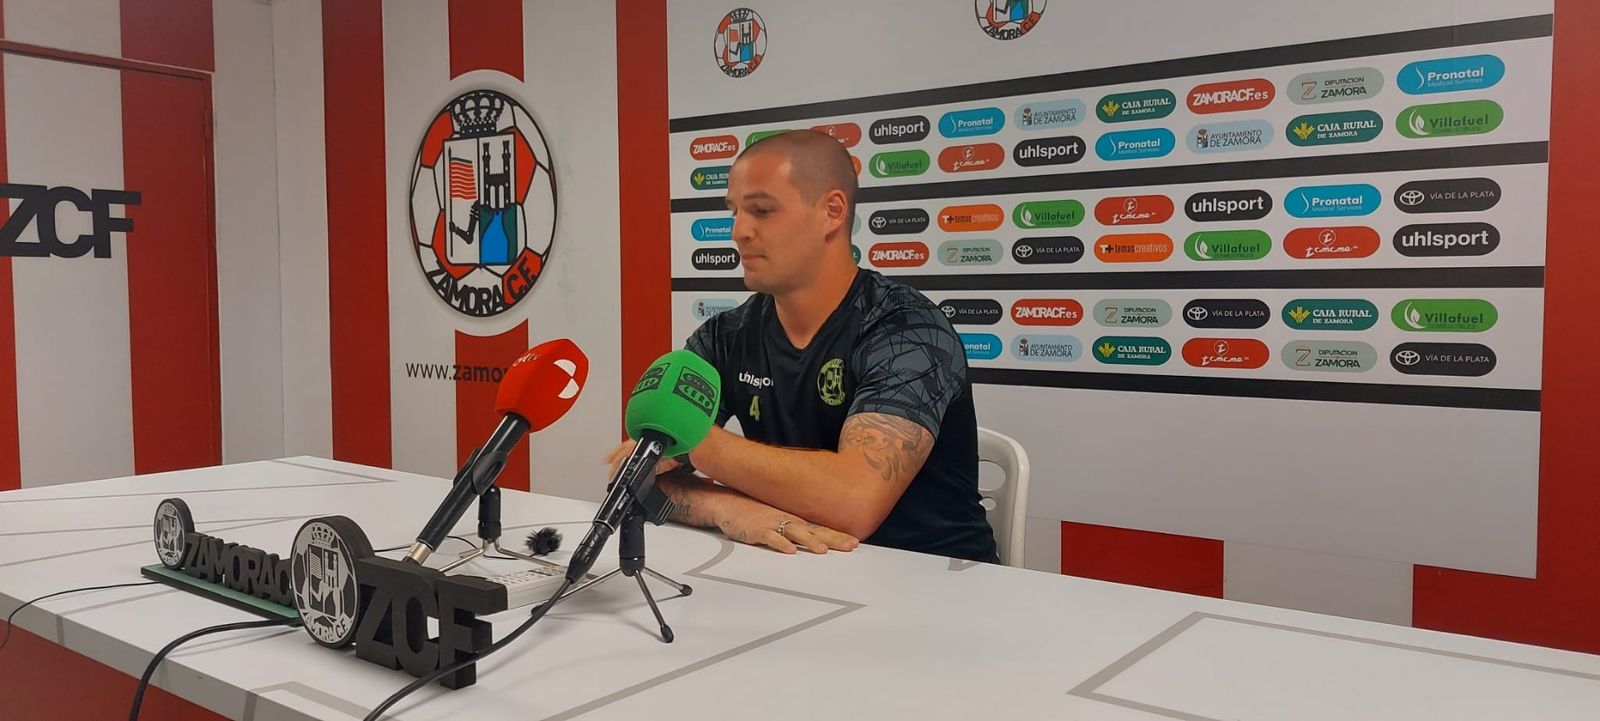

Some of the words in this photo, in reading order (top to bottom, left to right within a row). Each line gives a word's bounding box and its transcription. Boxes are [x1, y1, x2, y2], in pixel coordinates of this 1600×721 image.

[1427, 66, 1484, 81] Pronatal
[1193, 88, 1269, 106] ZAMORACF.es
[1321, 86, 1367, 98] ZAMORA
[1122, 101, 1141, 109] CAJA
[1143, 98, 1171, 107] RURAL
[958, 117, 993, 128] Pronatal
[1317, 122, 1340, 132] CAJA
[1343, 120, 1377, 130] RURAL
[1429, 113, 1489, 128] Villafuel
[874, 121, 925, 137] uhlsport
[1211, 129, 1262, 139] AYUNTAMIENTO
[1118, 137, 1160, 149] Pronatal
[1210, 139, 1221, 148] DE
[1222, 135, 1262, 146] ZAMORA
[1020, 141, 1079, 159] uhlsport
[1312, 195, 1363, 206] Pronatal
[1445, 192, 1456, 200] DE
[1458, 191, 1468, 199] LA
[1470, 190, 1495, 198] PLATA
[1192, 196, 1264, 214] uhlsport
[0, 183, 142, 259] ZCF
[1035, 211, 1075, 222] Villafuel
[1402, 230, 1489, 249] uhlsport
[1212, 243, 1260, 253] Villafuel
[695, 253, 736, 265] uhlsport
[426, 260, 505, 316] ZAMORA
[1312, 309, 1336, 318] CAJA
[1339, 309, 1372, 318] RURAL
[1425, 312, 1484, 324] Villafuel
[1121, 316, 1159, 324] ZAMORA
[964, 342, 991, 350] onatal
[1117, 345, 1137, 353] CAJA
[1138, 345, 1166, 354] RURAL
[1315, 358, 1361, 368] ZAMORA
[683, 386, 710, 407] CERO
[749, 395, 761, 421] 4
[185, 532, 292, 606] ZAMORAC
[356, 555, 508, 690] ZCF
